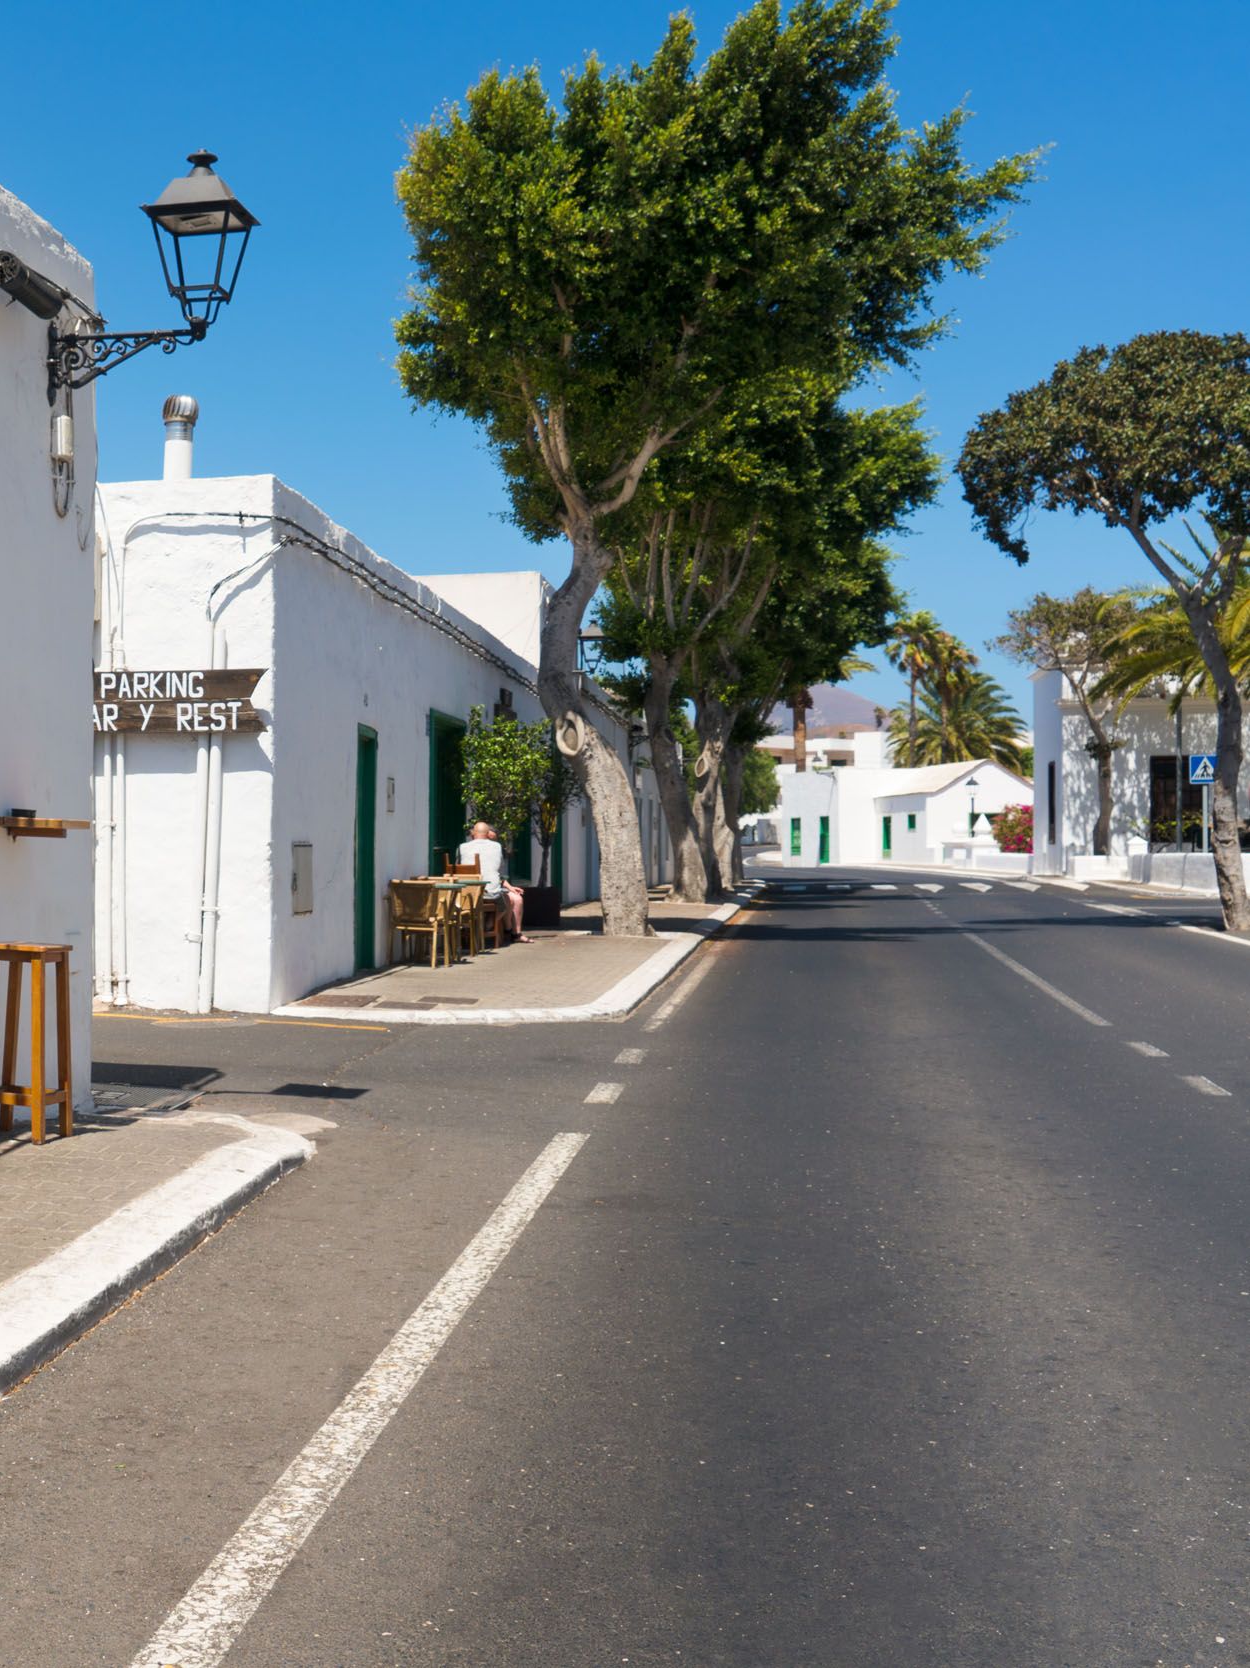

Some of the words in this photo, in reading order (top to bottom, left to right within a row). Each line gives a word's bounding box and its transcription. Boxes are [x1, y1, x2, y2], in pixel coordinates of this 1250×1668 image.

[100, 672, 204, 699] PARKING
[139, 704, 154, 732] Y
[176, 702, 242, 732] REST
